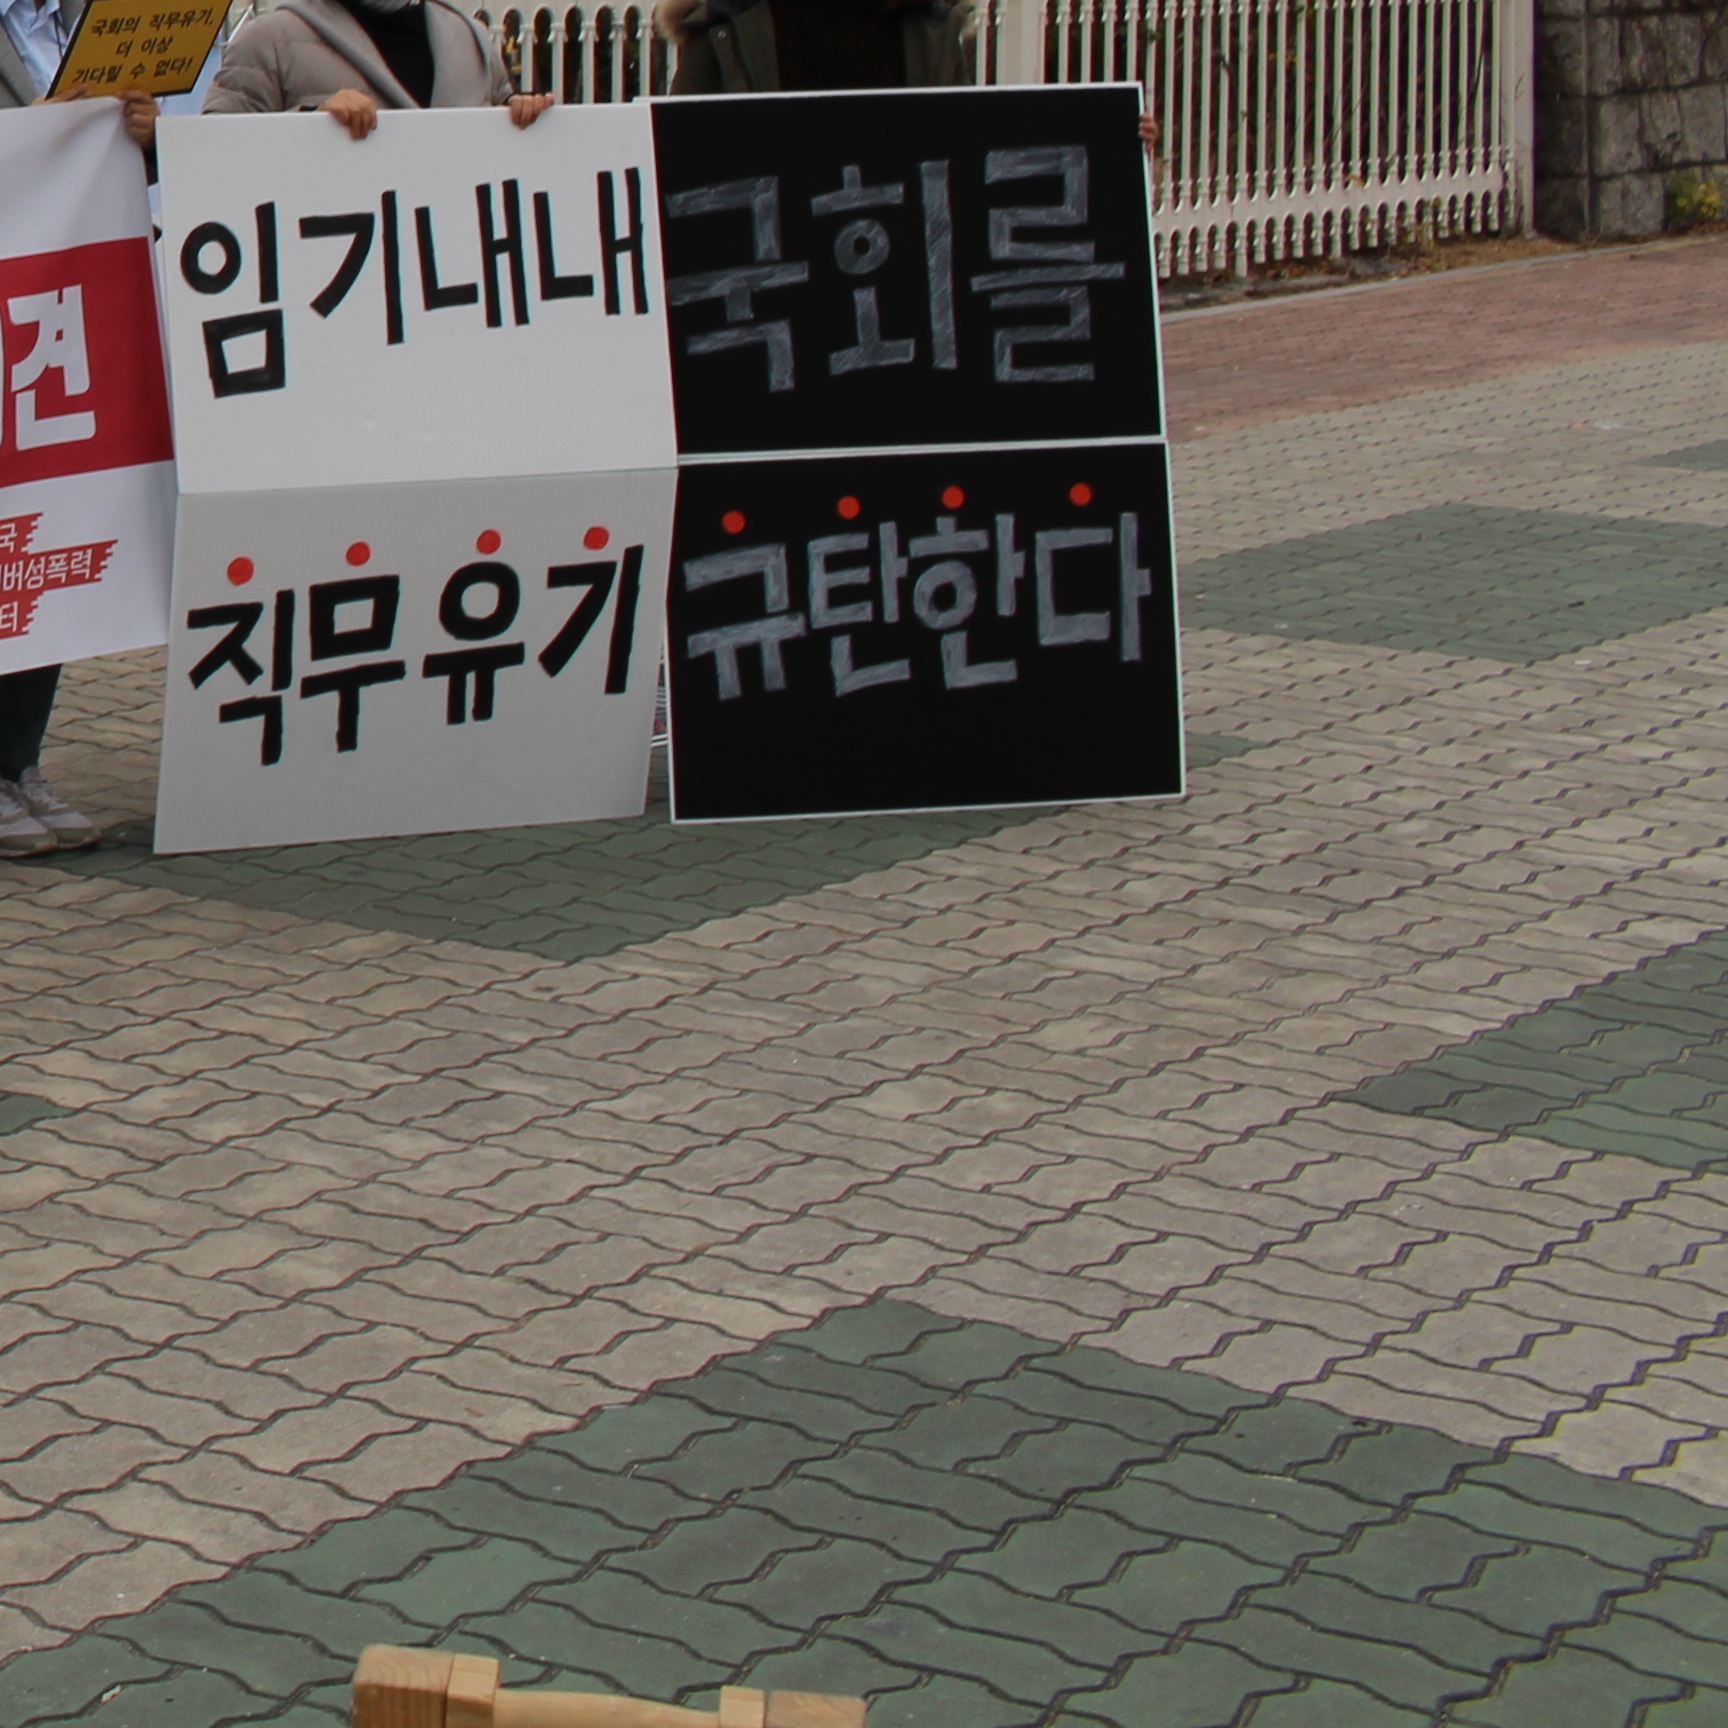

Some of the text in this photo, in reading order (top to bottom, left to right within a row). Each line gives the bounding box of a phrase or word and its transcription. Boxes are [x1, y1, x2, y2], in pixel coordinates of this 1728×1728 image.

[72, 57, 194, 84] 기다릴 수 없다!
[91, 8, 214, 38] 국회의 직무유기,
[116, 36, 173, 57] 더 이상
[180, 167, 649, 400] 임기내내
[664, 144, 1126, 393] 국회를
[186, 544, 644, 767] 직무유기
[682, 512, 1152, 700] 규탄한다
